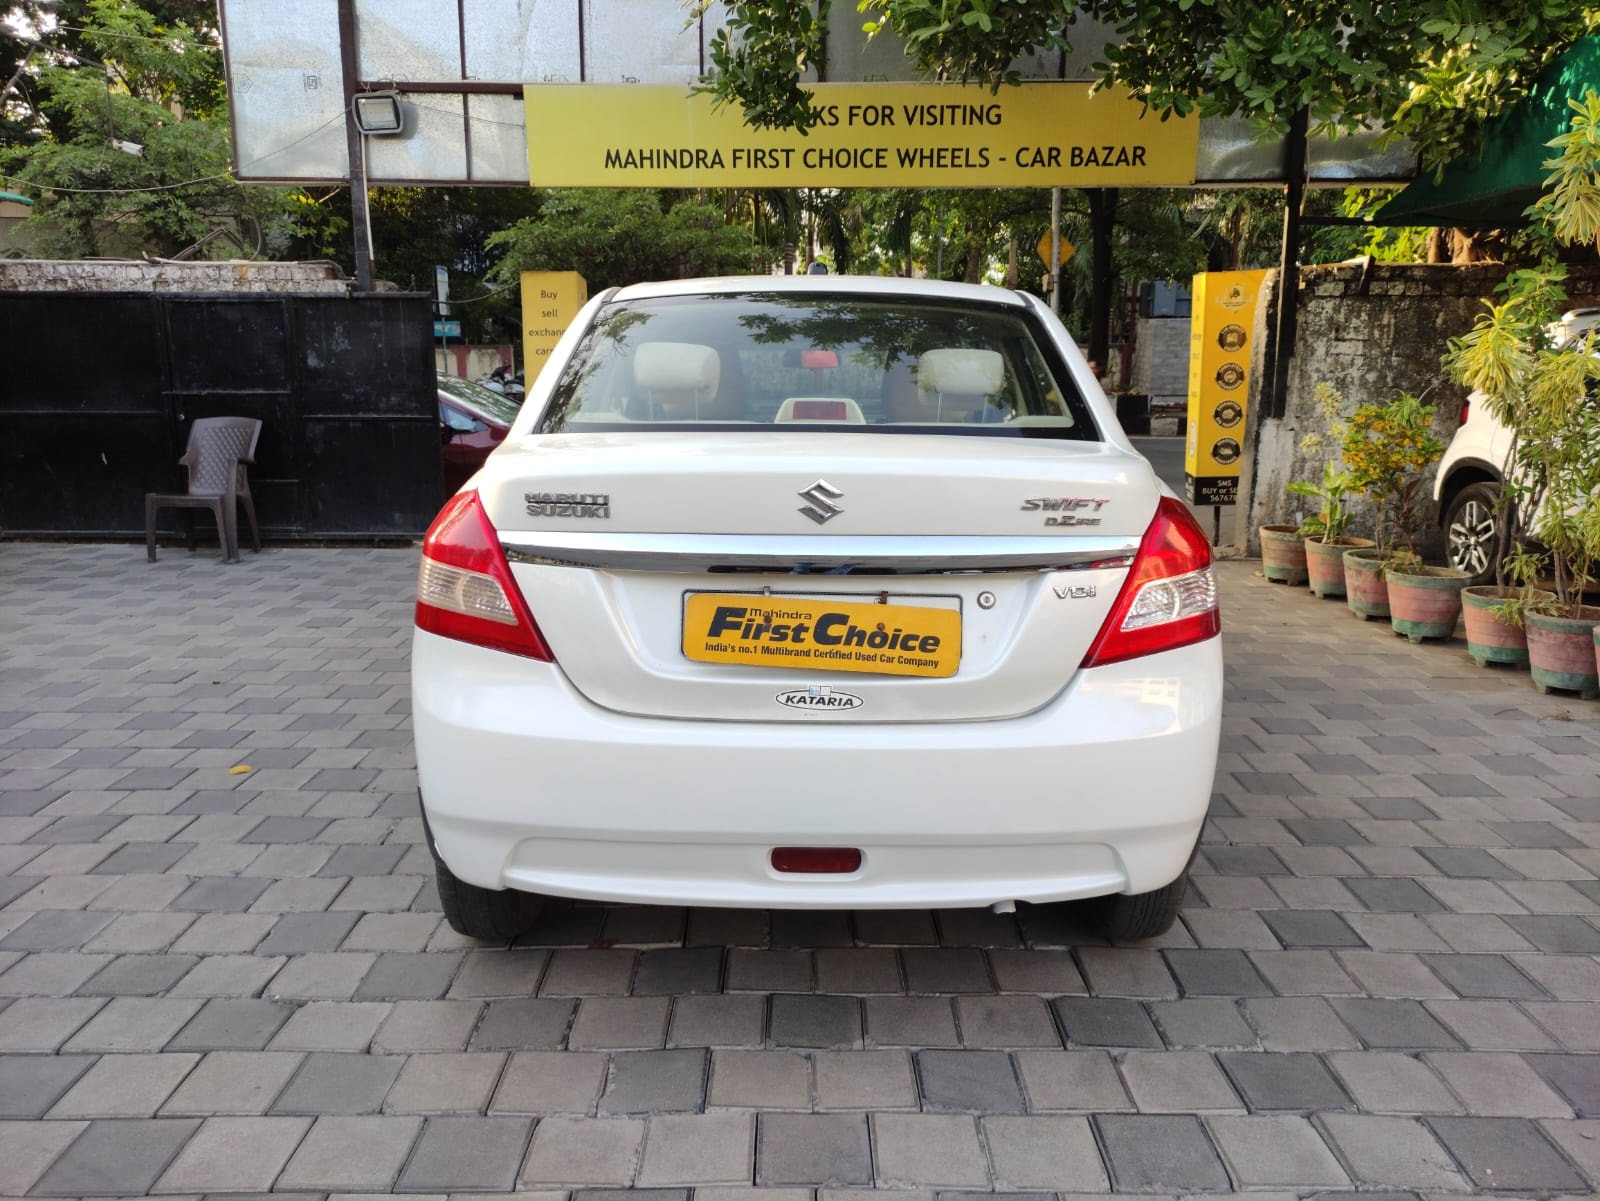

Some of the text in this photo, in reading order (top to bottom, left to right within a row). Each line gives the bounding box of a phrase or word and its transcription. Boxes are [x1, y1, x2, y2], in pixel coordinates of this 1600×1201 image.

[848, 105, 895, 126] FOR
[903, 104, 1002, 126] VISITING
[604, 148, 725, 169] MAHINDRA
[732, 148, 796, 169] FIRST
[802, 148, 888, 169] CHOICE
[896, 147, 990, 169] WHEELS
[1015, 146, 1062, 168] CAR
[1070, 145, 1147, 168] BAZAR
[540, 290, 558, 300] Buy
[541, 309, 558, 318] sell
[528, 327, 566, 337] exchan
[1217, 479, 1232, 487] SMS
[1202, 487, 1217, 495] BUY
[524, 492, 610, 506] MARUTI
[1020, 498, 1110, 512] SWIFT
[526, 503, 610, 519] SUZUKI
[749, 607, 812, 620] Mahindra
[707, 606, 941, 654] First Choice
[705, 642, 939, 669] India's no.1 Multibrand Certified Used Car Company
[785, 694, 854, 707] KATARIA
